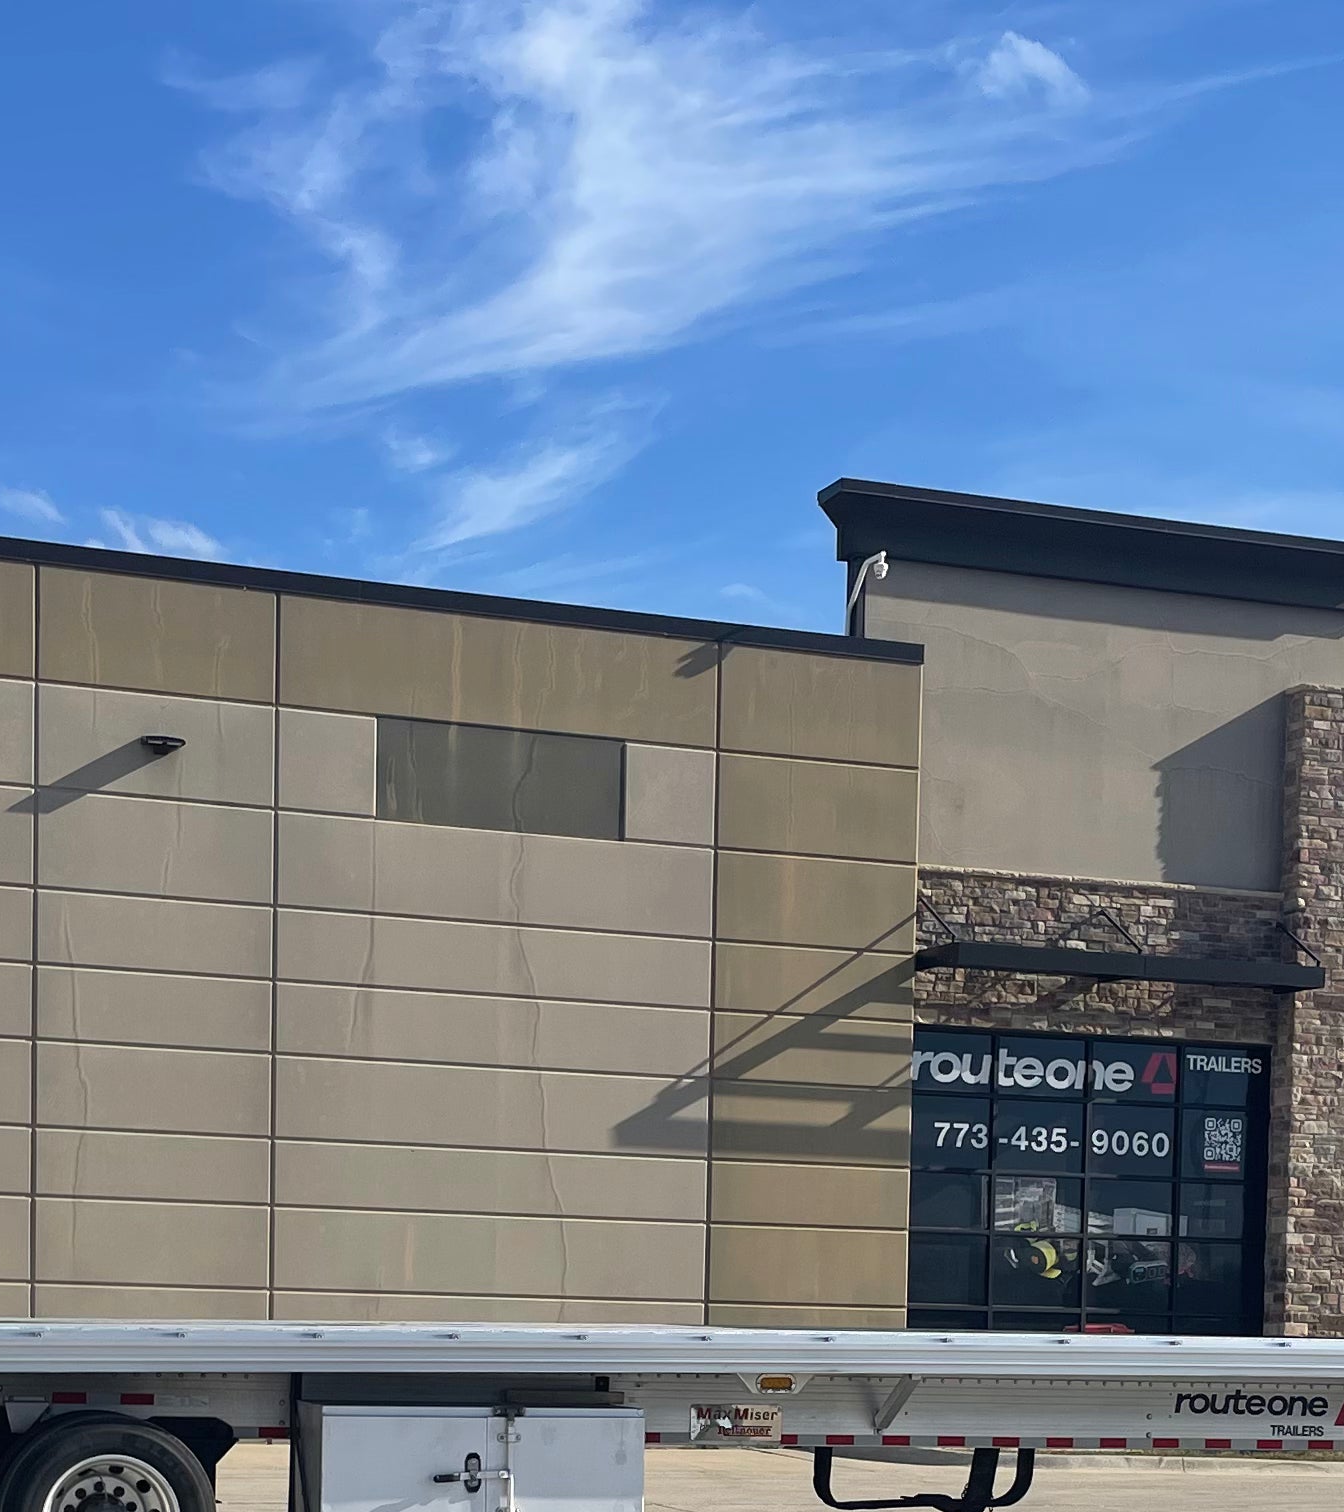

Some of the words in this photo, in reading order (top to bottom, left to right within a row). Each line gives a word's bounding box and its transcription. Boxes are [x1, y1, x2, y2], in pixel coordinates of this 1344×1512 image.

[912, 1048, 1135, 1093] routeone
[1186, 1054, 1263, 1075] TRAILERS
[1174, 1389, 1329, 1417] routeone
[1270, 1424, 1324, 1437] TRAILERS
